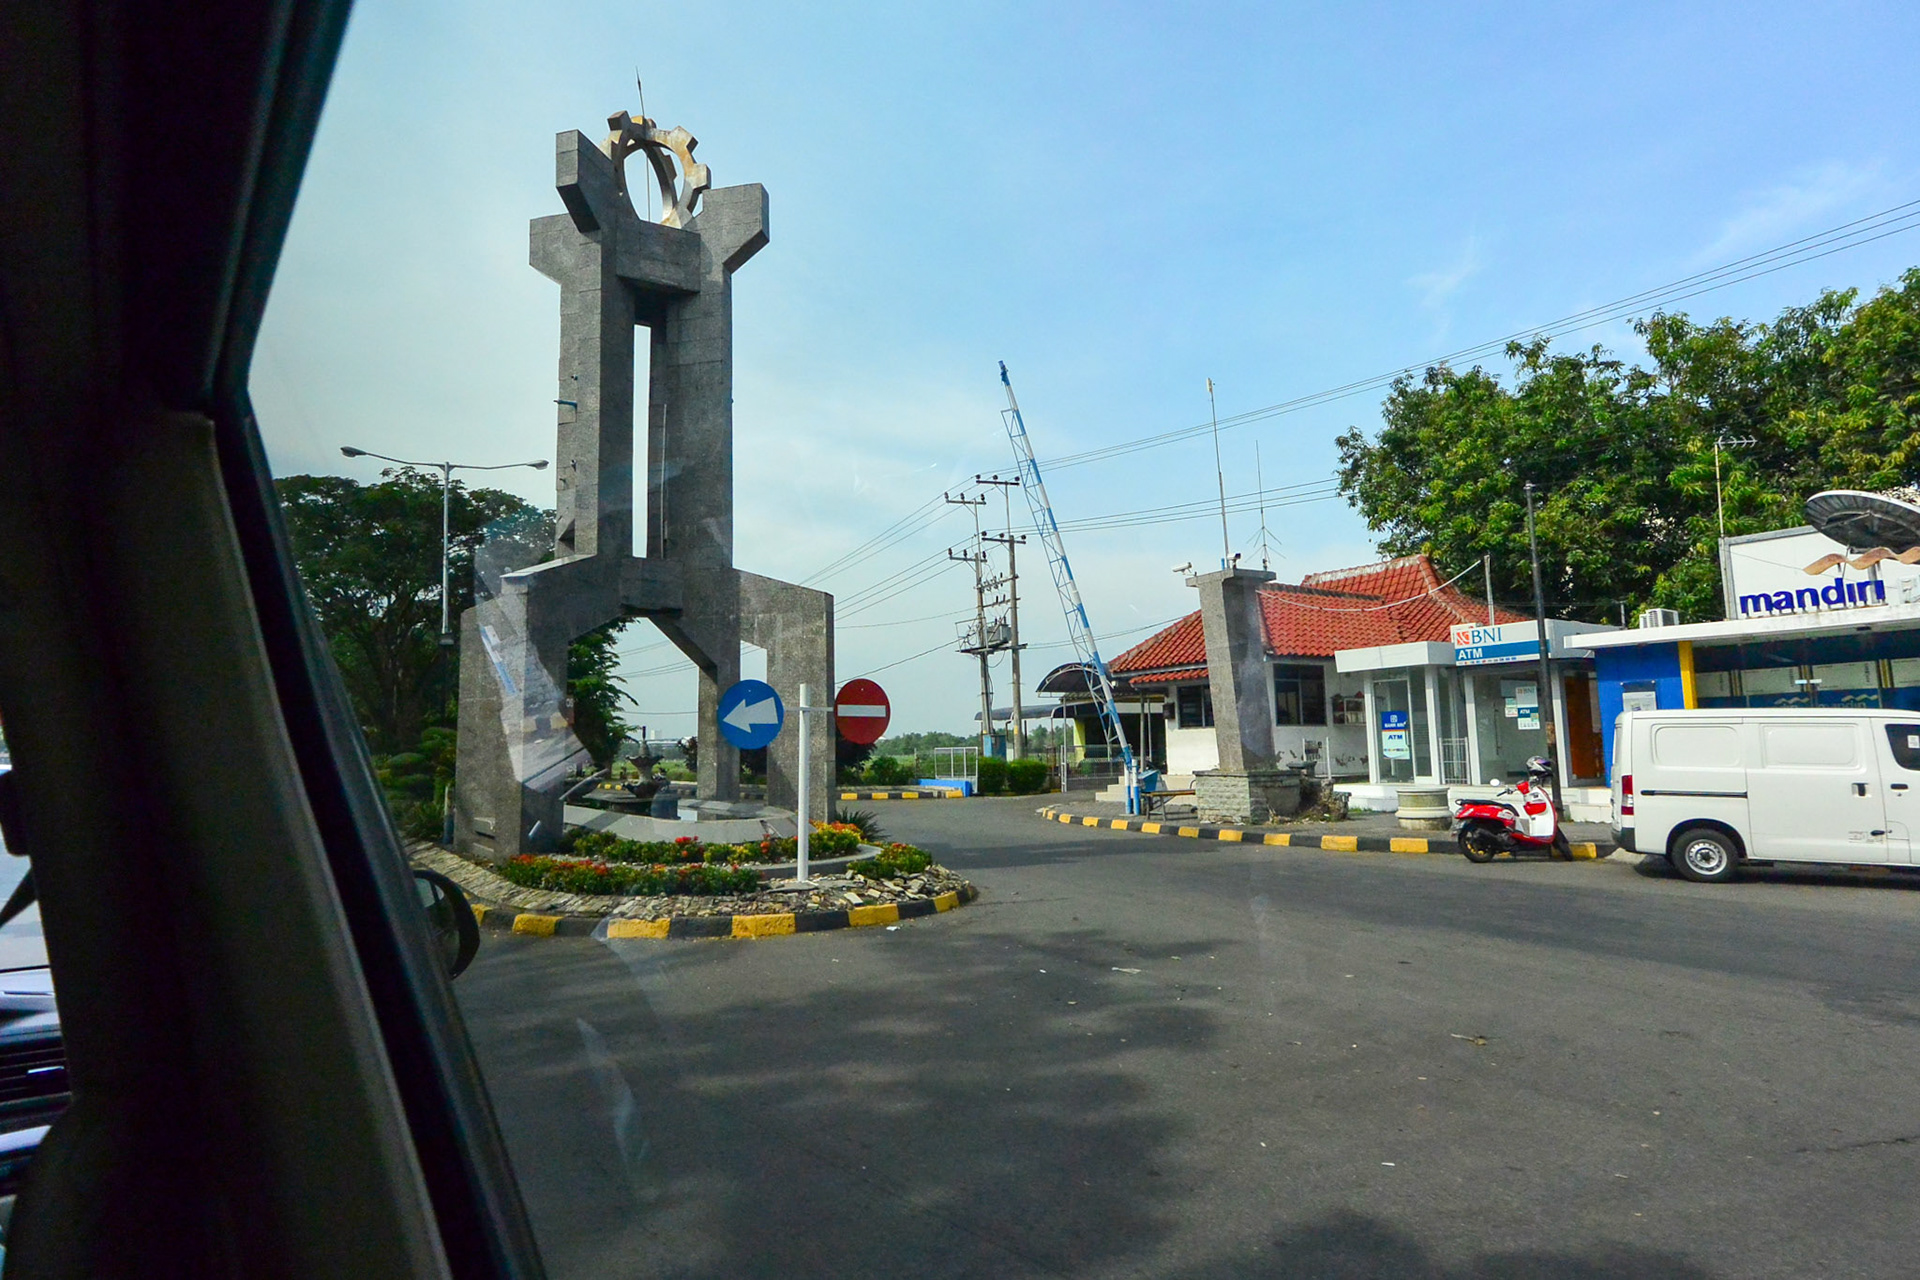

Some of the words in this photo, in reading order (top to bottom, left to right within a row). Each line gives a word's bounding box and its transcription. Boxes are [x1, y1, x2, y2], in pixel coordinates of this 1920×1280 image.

[1739, 578, 1885, 613] mandiri
[1471, 627, 1502, 644] BNI
[1458, 648, 1483, 659] ATM
